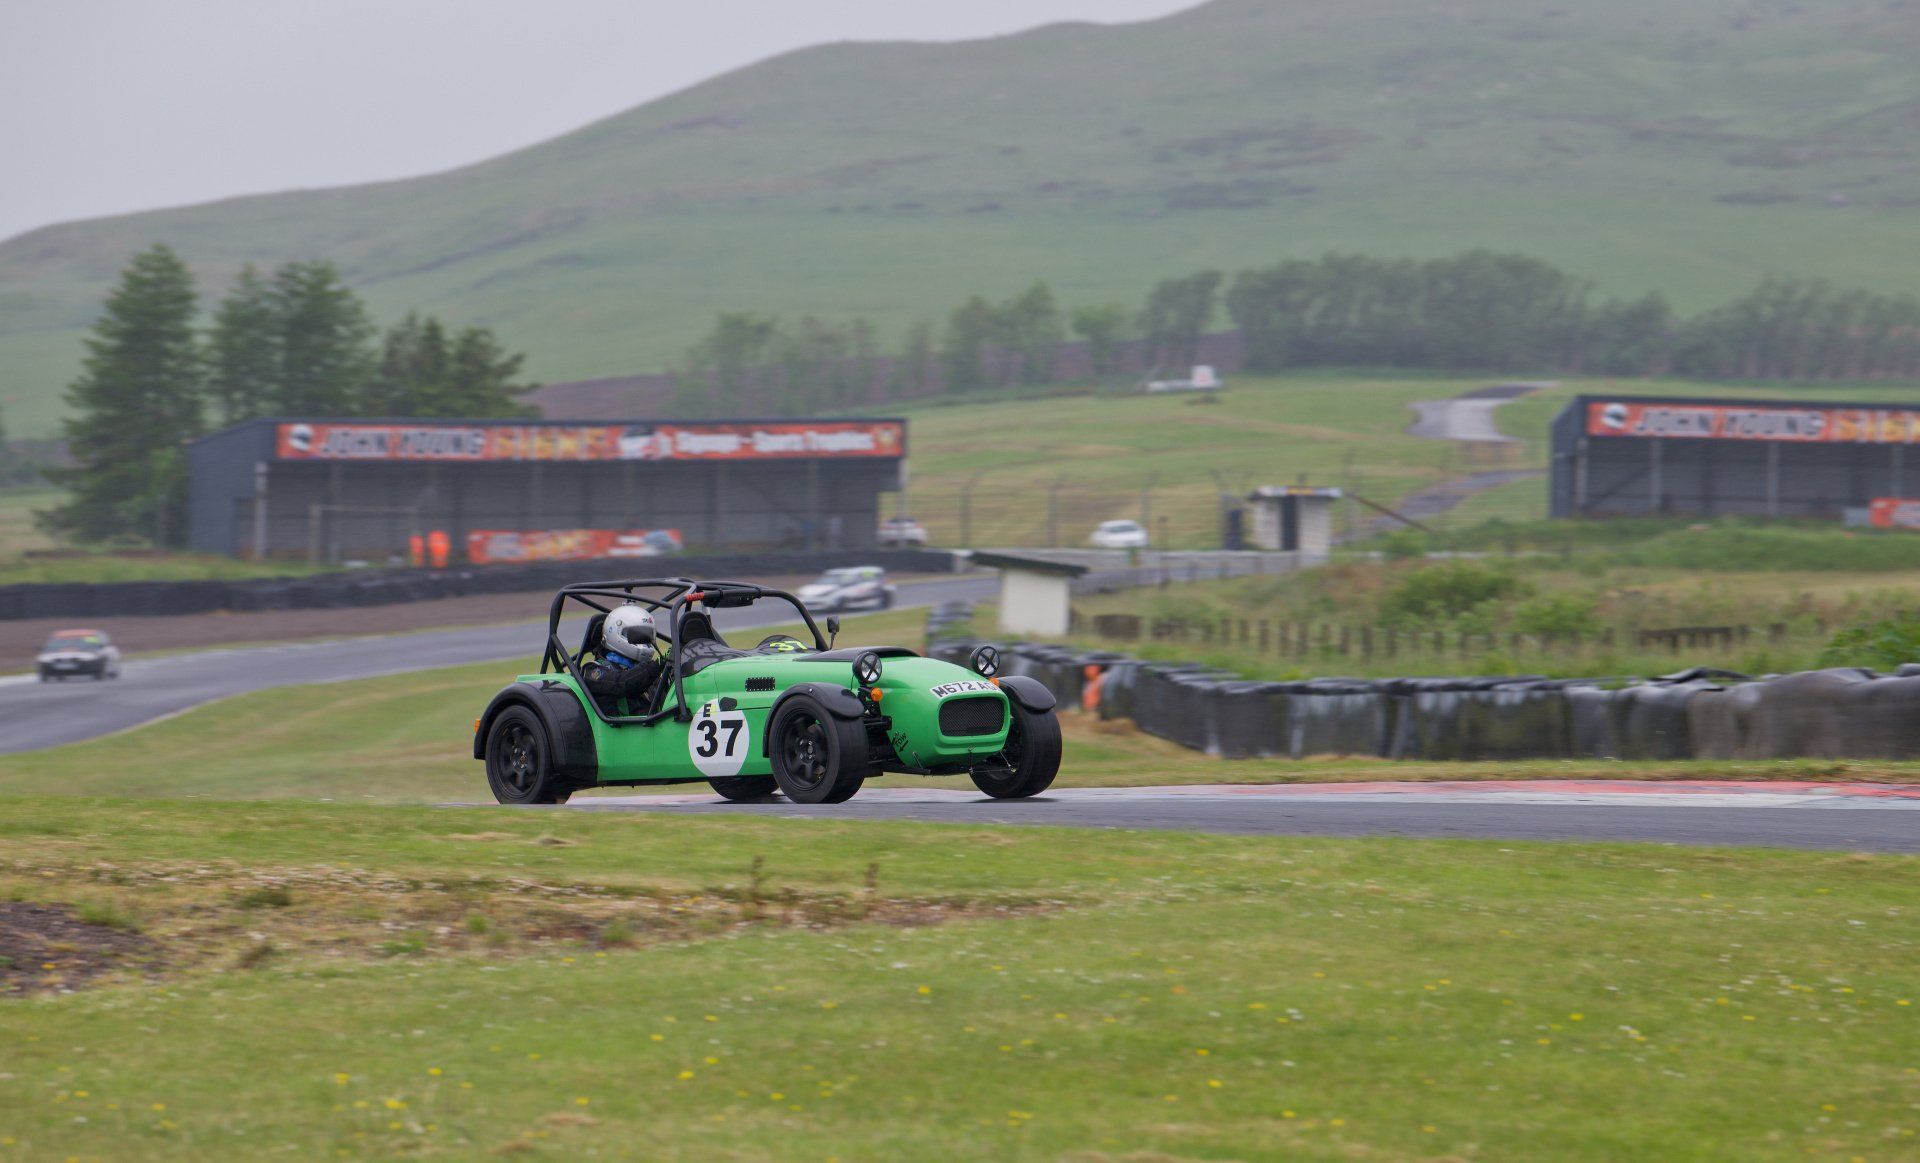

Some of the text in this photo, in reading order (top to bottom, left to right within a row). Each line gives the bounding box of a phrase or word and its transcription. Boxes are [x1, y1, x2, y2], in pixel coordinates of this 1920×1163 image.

[769, 640, 807, 653] 37
[932, 682, 976, 698] M672
[696, 720, 744, 758] 37
